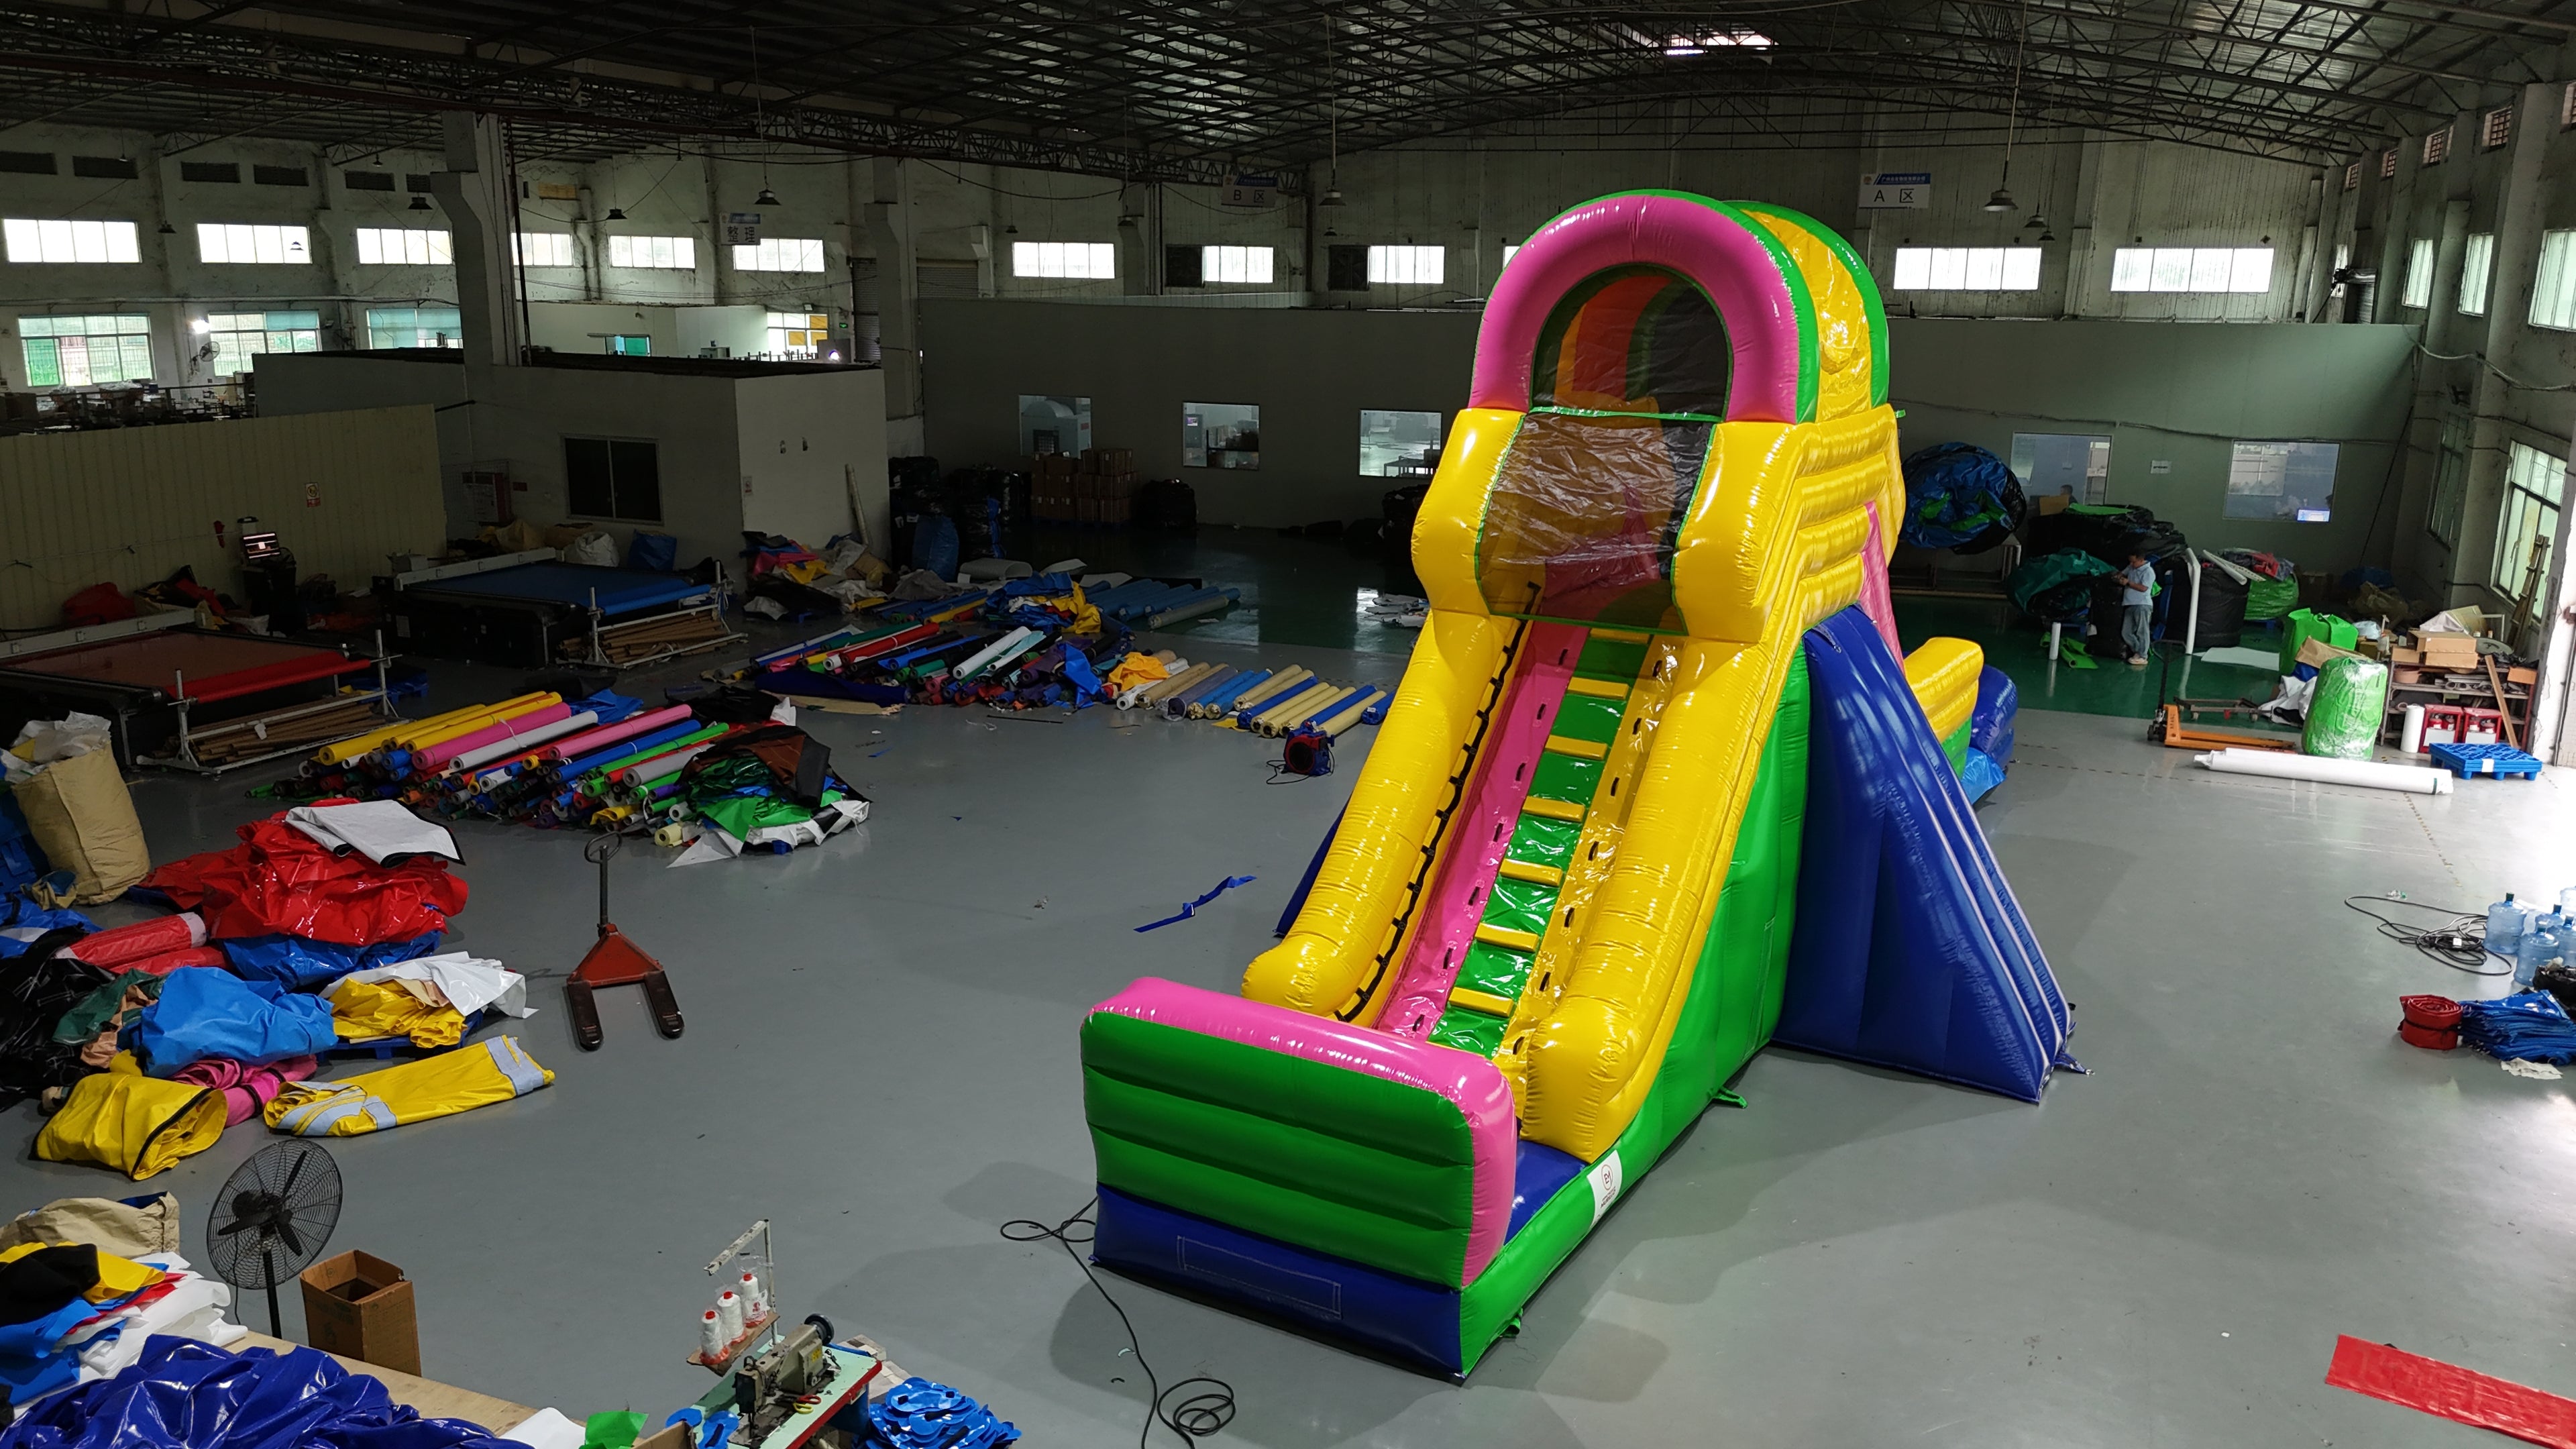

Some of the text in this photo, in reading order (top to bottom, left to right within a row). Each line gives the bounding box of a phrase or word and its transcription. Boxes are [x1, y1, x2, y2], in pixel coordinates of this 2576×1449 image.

[1234, 189, 1265, 203] B 区
[1874, 189, 1915, 203] A 区
